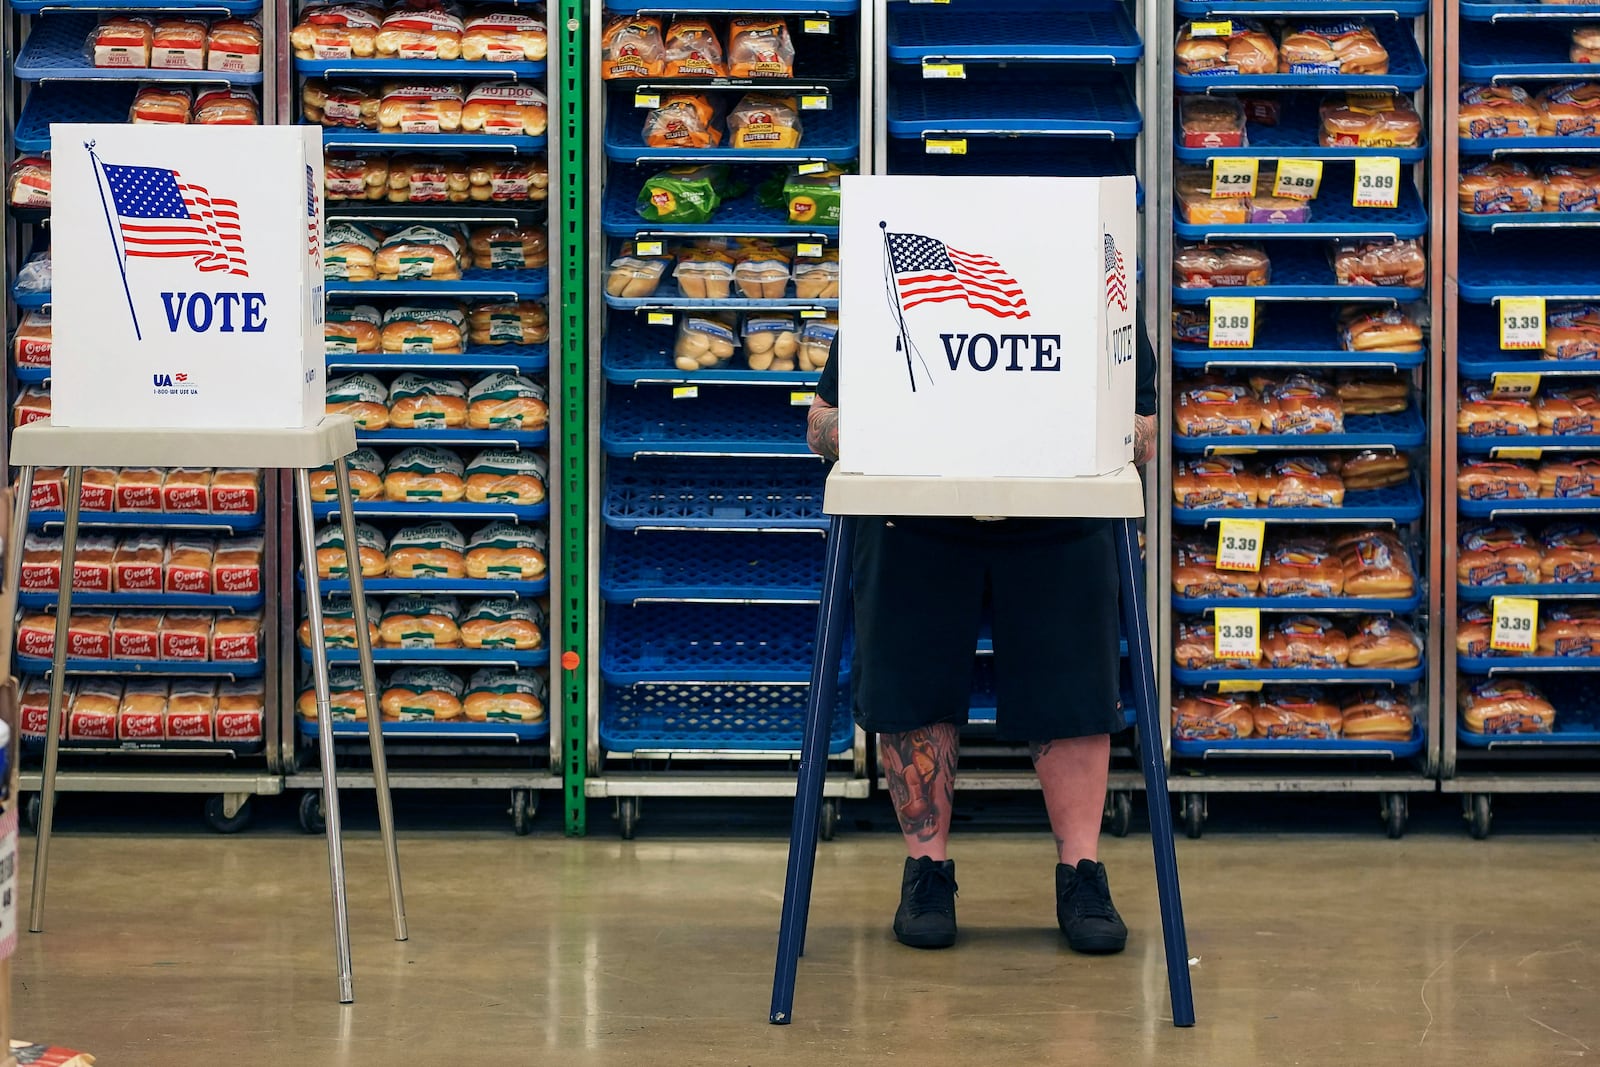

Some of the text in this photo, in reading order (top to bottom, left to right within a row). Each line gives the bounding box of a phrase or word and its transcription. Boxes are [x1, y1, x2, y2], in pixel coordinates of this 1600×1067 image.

[508, 88, 533, 97] DOG
[1216, 174, 1251, 185] $4.29
[1279, 176, 1314, 187] $3.89
[1358, 175, 1394, 188] $3.89
[1277, 191, 1311, 200] SPECIAL
[161, 292, 268, 333] VOTE
[1214, 316, 1249, 329] $3.89
[1504, 316, 1539, 329] $3.39
[1113, 324, 1132, 366] VOTE
[939, 333, 1061, 371] VOTE
[154, 374, 173, 386] UA
[32, 485, 51, 496] ven
[123, 487, 153, 500] Oven
[170, 488, 199, 501] Oven
[217, 489, 247, 502] Oven
[1222, 537, 1257, 551] $3.39
[1220, 561, 1256, 570] SPECIAL
[23, 567, 53, 579] Oven
[124, 568, 152, 580] Oven
[174, 570, 203, 583] Oven
[221, 570, 251, 583] Oven
[1496, 617, 1531, 631] $3.39
[25, 631, 55, 644] Oven
[1218, 625, 1254, 638] $3.39
[73, 634, 103, 645] Oven
[120, 634, 150, 646] Oven
[168, 635, 199, 648] Oven
[219, 638, 249, 650] Oven
[1495, 641, 1530, 649] SPECIAL
[78, 716, 108, 728] Oven
[127, 714, 156, 728] Oven
[173, 714, 203, 728] Oven
[222, 714, 252, 728] Oven
